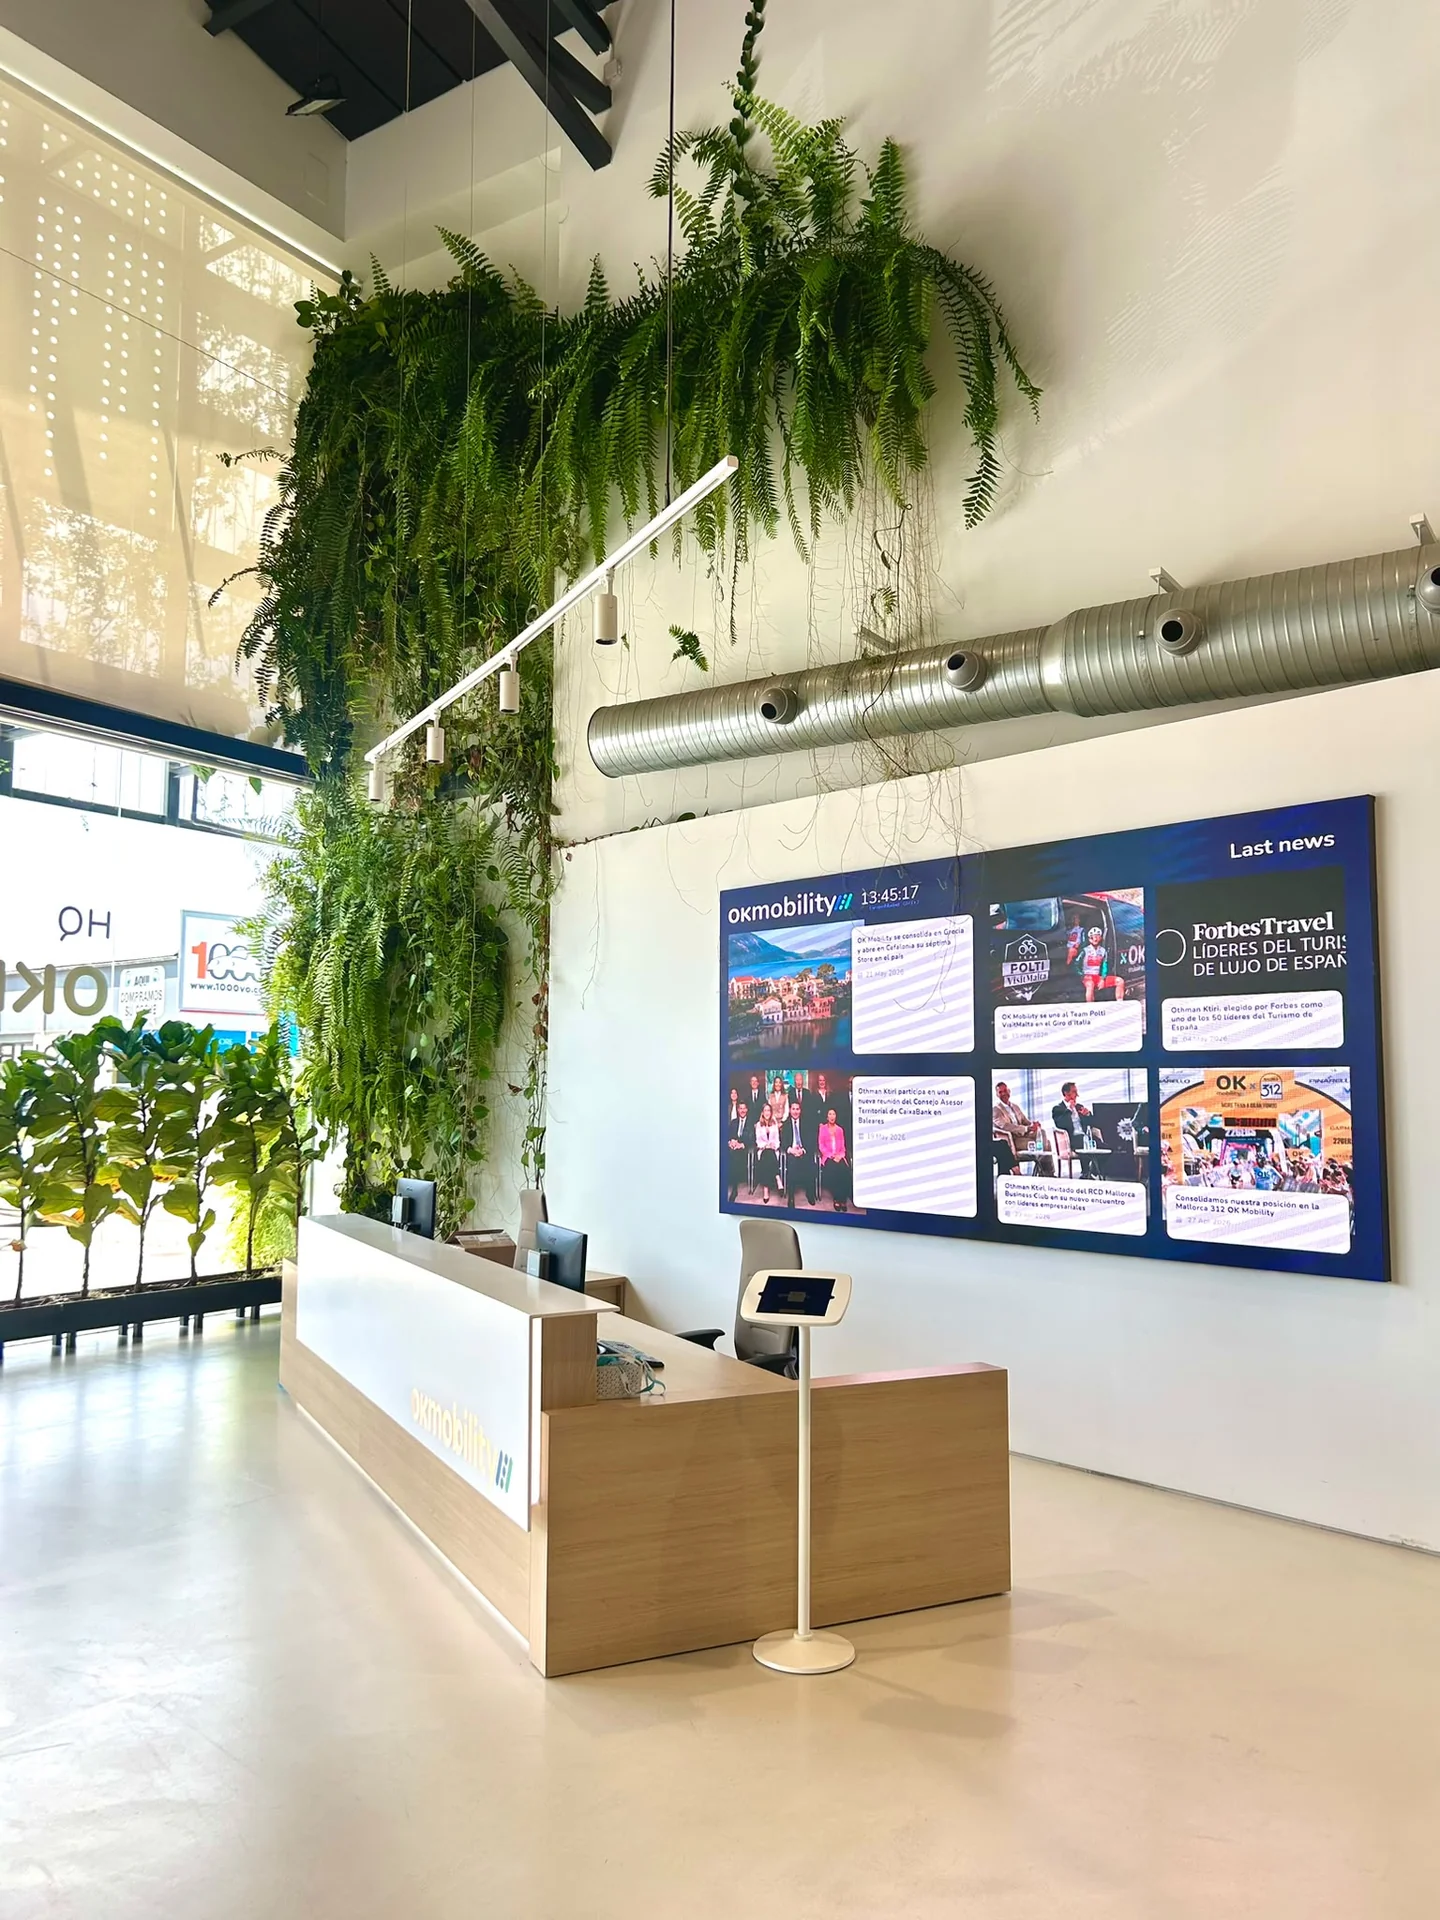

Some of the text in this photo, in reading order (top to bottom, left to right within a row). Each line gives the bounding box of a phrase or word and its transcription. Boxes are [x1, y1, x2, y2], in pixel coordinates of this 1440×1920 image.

[1230, 834, 1335, 859] Last news
[861, 885, 919, 905] 13:45:17
[943, 927, 964, 935] Grecia
[1193, 941, 1258, 960] LÍDERES
[1263, 938, 1296, 955] DEL
[1010, 961, 1045, 974] POLTI
[1193, 963, 1215, 976] DE
[1219, 959, 1261, 975] LUJO
[1266, 957, 1288, 972] DE
[1089, 1009, 1106, 1017] Polti
[1171, 1006, 1201, 1014] Othman
[1254, 1004, 1268, 1012] por
[1270, 1002, 1298, 1010] Forbes
[1252, 1012, 1266, 1020] del
[1267, 1011, 1300, 1020] Turismo
[1302, 1010, 1313, 1018] de
[1052, 1019, 1066, 1027] Giro
[1171, 1024, 1198, 1032] España
[858, 1087, 882, 1095] Othman
[898, 1087, 926, 1096] participa
[1216, 1075, 1247, 1091] OK
[1260, 1083, 1282, 1097] 312
[901, 1098, 912, 1106] del
[913, 1097, 939, 1107] Consejo
[940, 1098, 963, 1106] Asesor
[858, 1107, 888, 1115] Territorial
[858, 1117, 885, 1125] Baleares
[1004, 1182, 1030, 1191] Othman
[1075, 1187, 1087, 1195] del
[1088, 1187, 1103, 1196] RCD
[1105, 1189, 1136, 1198] Mallorca
[1004, 1190, 1032, 1199] Business
[1033, 1191, 1049, 1200] Club
[1091, 1197, 1126, 1206] encuentro
[1175, 1193, 1228, 1205] Consolidamos
[1230, 1198, 1260, 1207] nuestra
[1311, 1202, 1320, 1210] la
[1040, 1202, 1086, 1211] empresariales
[1175, 1203, 1275, 1217] Mallorca 312 OK Mobility
